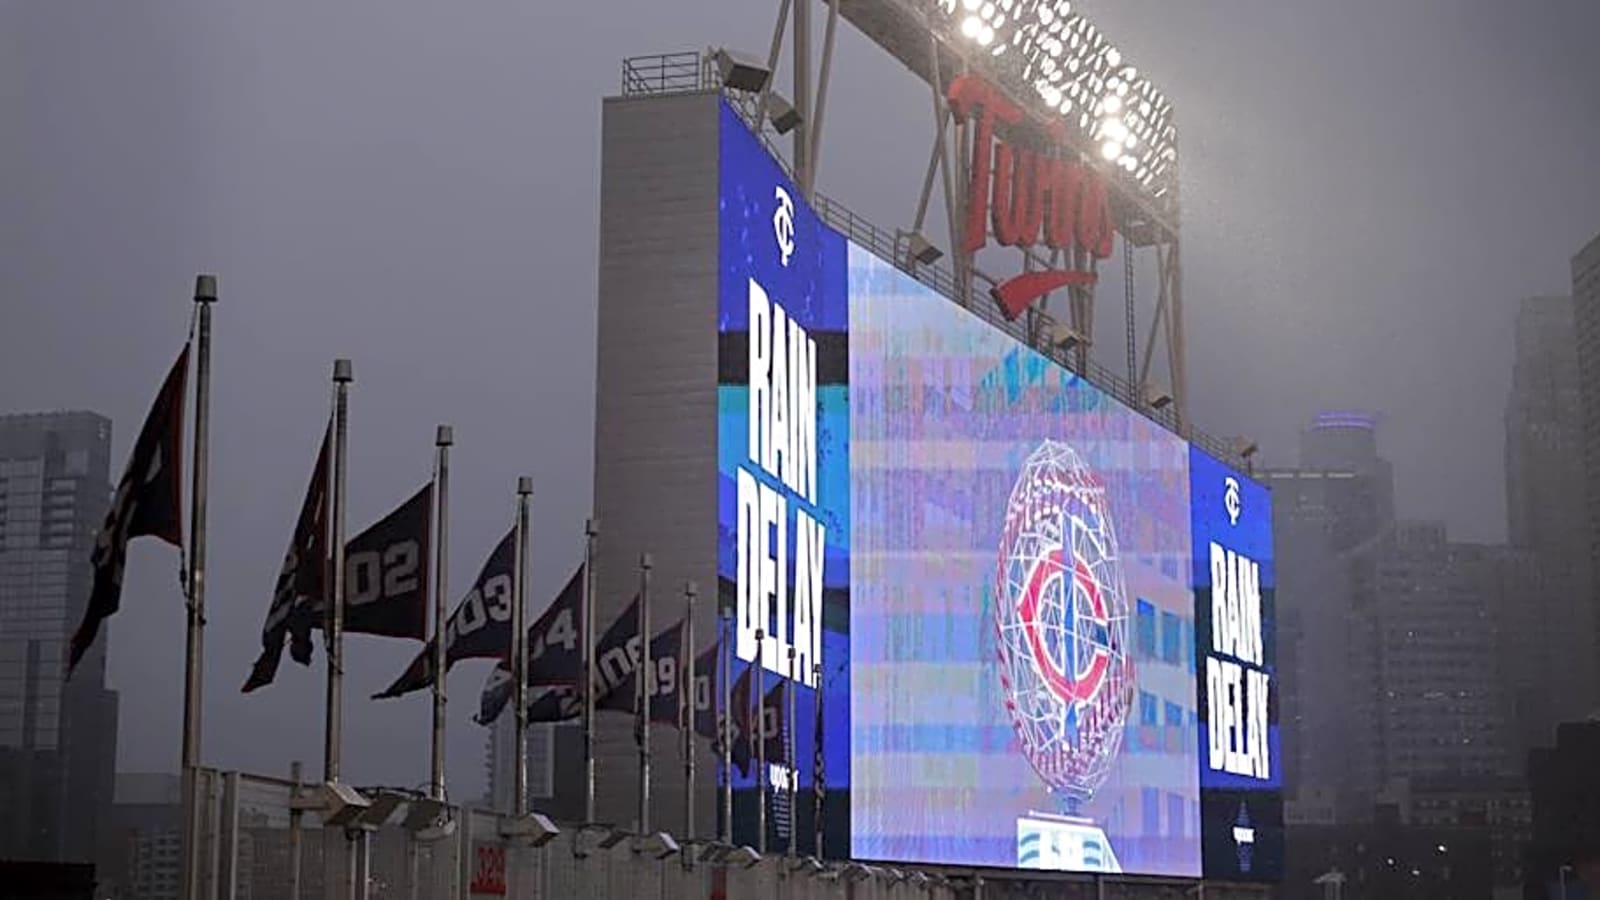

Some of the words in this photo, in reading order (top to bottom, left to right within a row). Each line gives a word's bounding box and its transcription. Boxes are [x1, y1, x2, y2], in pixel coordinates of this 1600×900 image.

[749, 276, 817, 507] RAIN
[736, 466, 826, 689] DELAY
[1210, 541, 1263, 667] RAIN
[1206, 656, 1270, 780] DELAY
